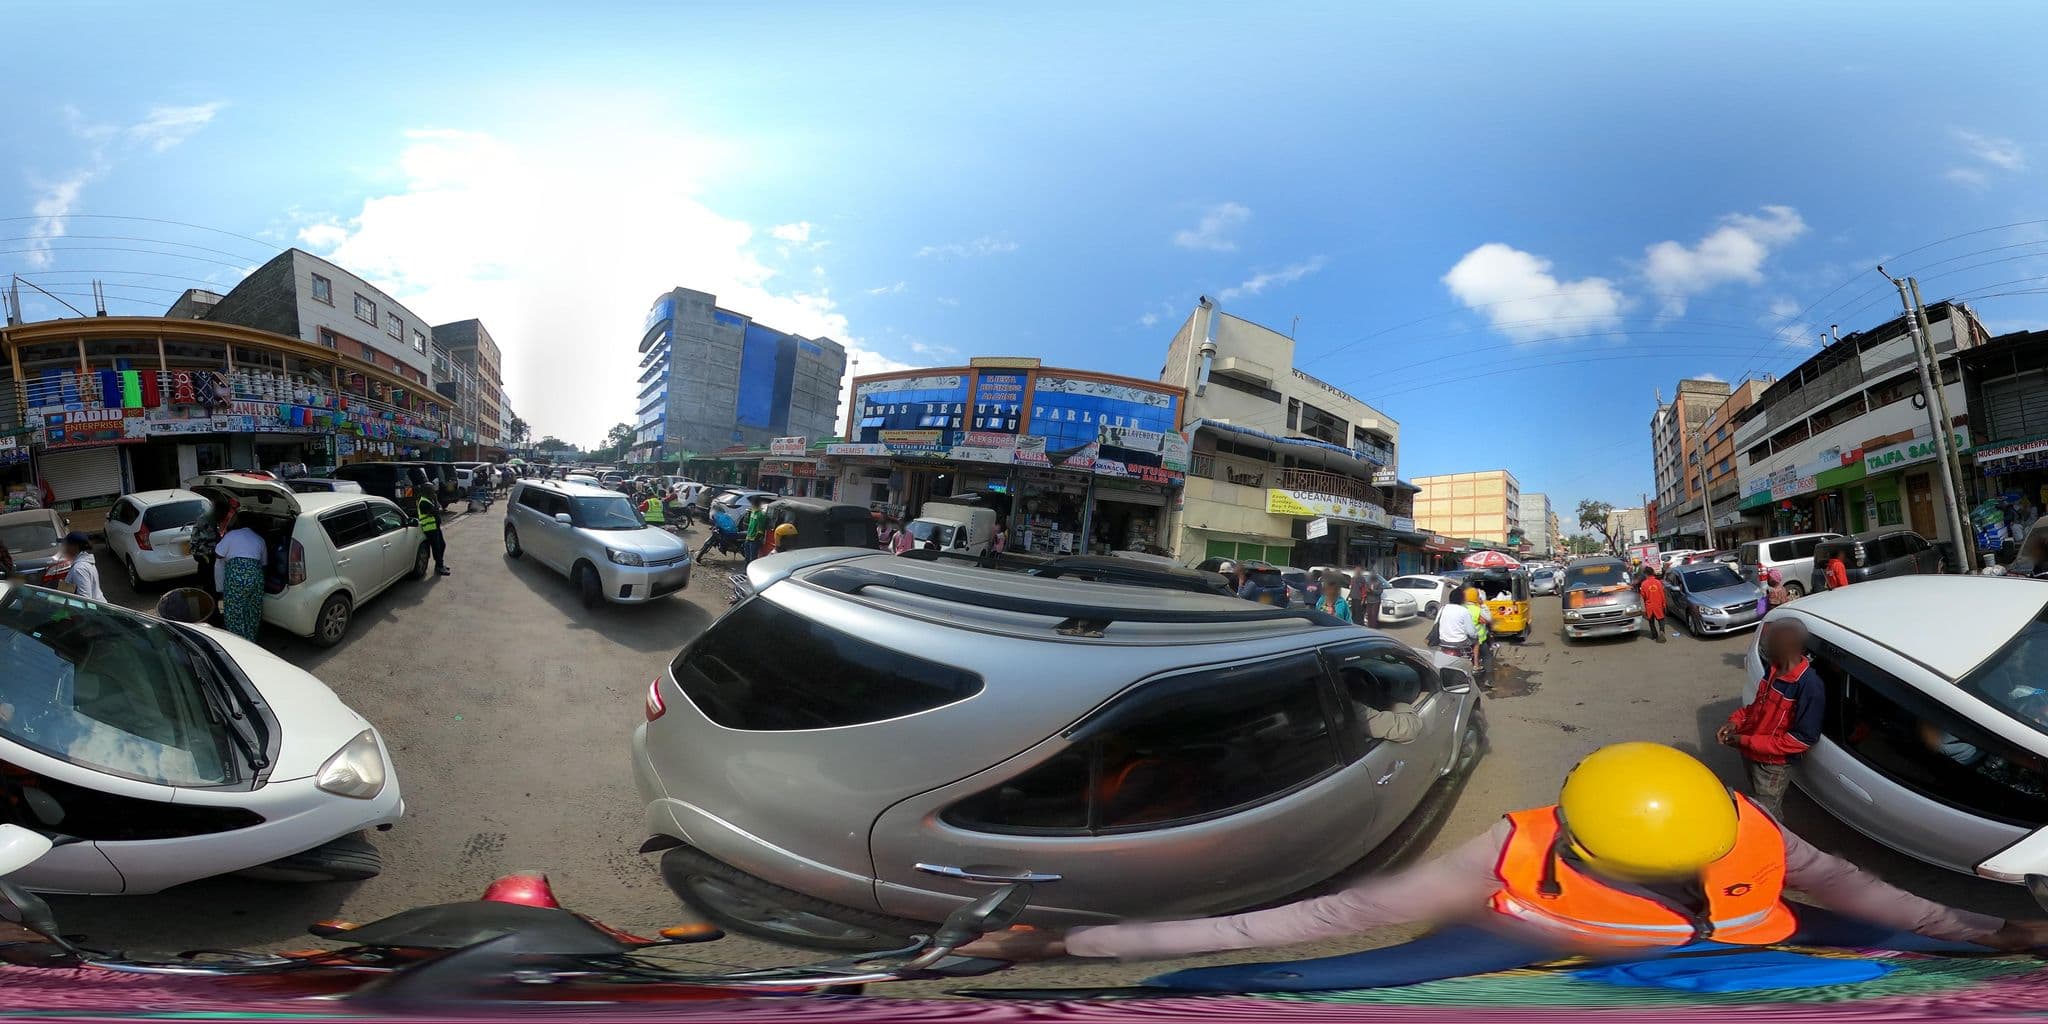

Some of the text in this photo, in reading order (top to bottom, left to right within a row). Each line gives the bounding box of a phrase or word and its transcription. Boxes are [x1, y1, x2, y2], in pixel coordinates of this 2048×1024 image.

[65, 409, 123, 425] JADID
[865, 404, 908, 416] MWAS
[1035, 406, 1139, 430] PARLOUR
[922, 416, 1017, 431] AKURU
[65, 420, 124, 432] ENTERPRISES
[986, 436, 1015, 446] STORES
[835, 447, 865, 455] CHEMIST
[1978, 447, 2004, 459] MUCHIRI
[1867, 449, 1906, 470] TAIFA
[1127, 463, 1184, 478] MITUMBA
[1293, 491, 1333, 503] OCEANA
[1333, 495, 1347, 505] INN
